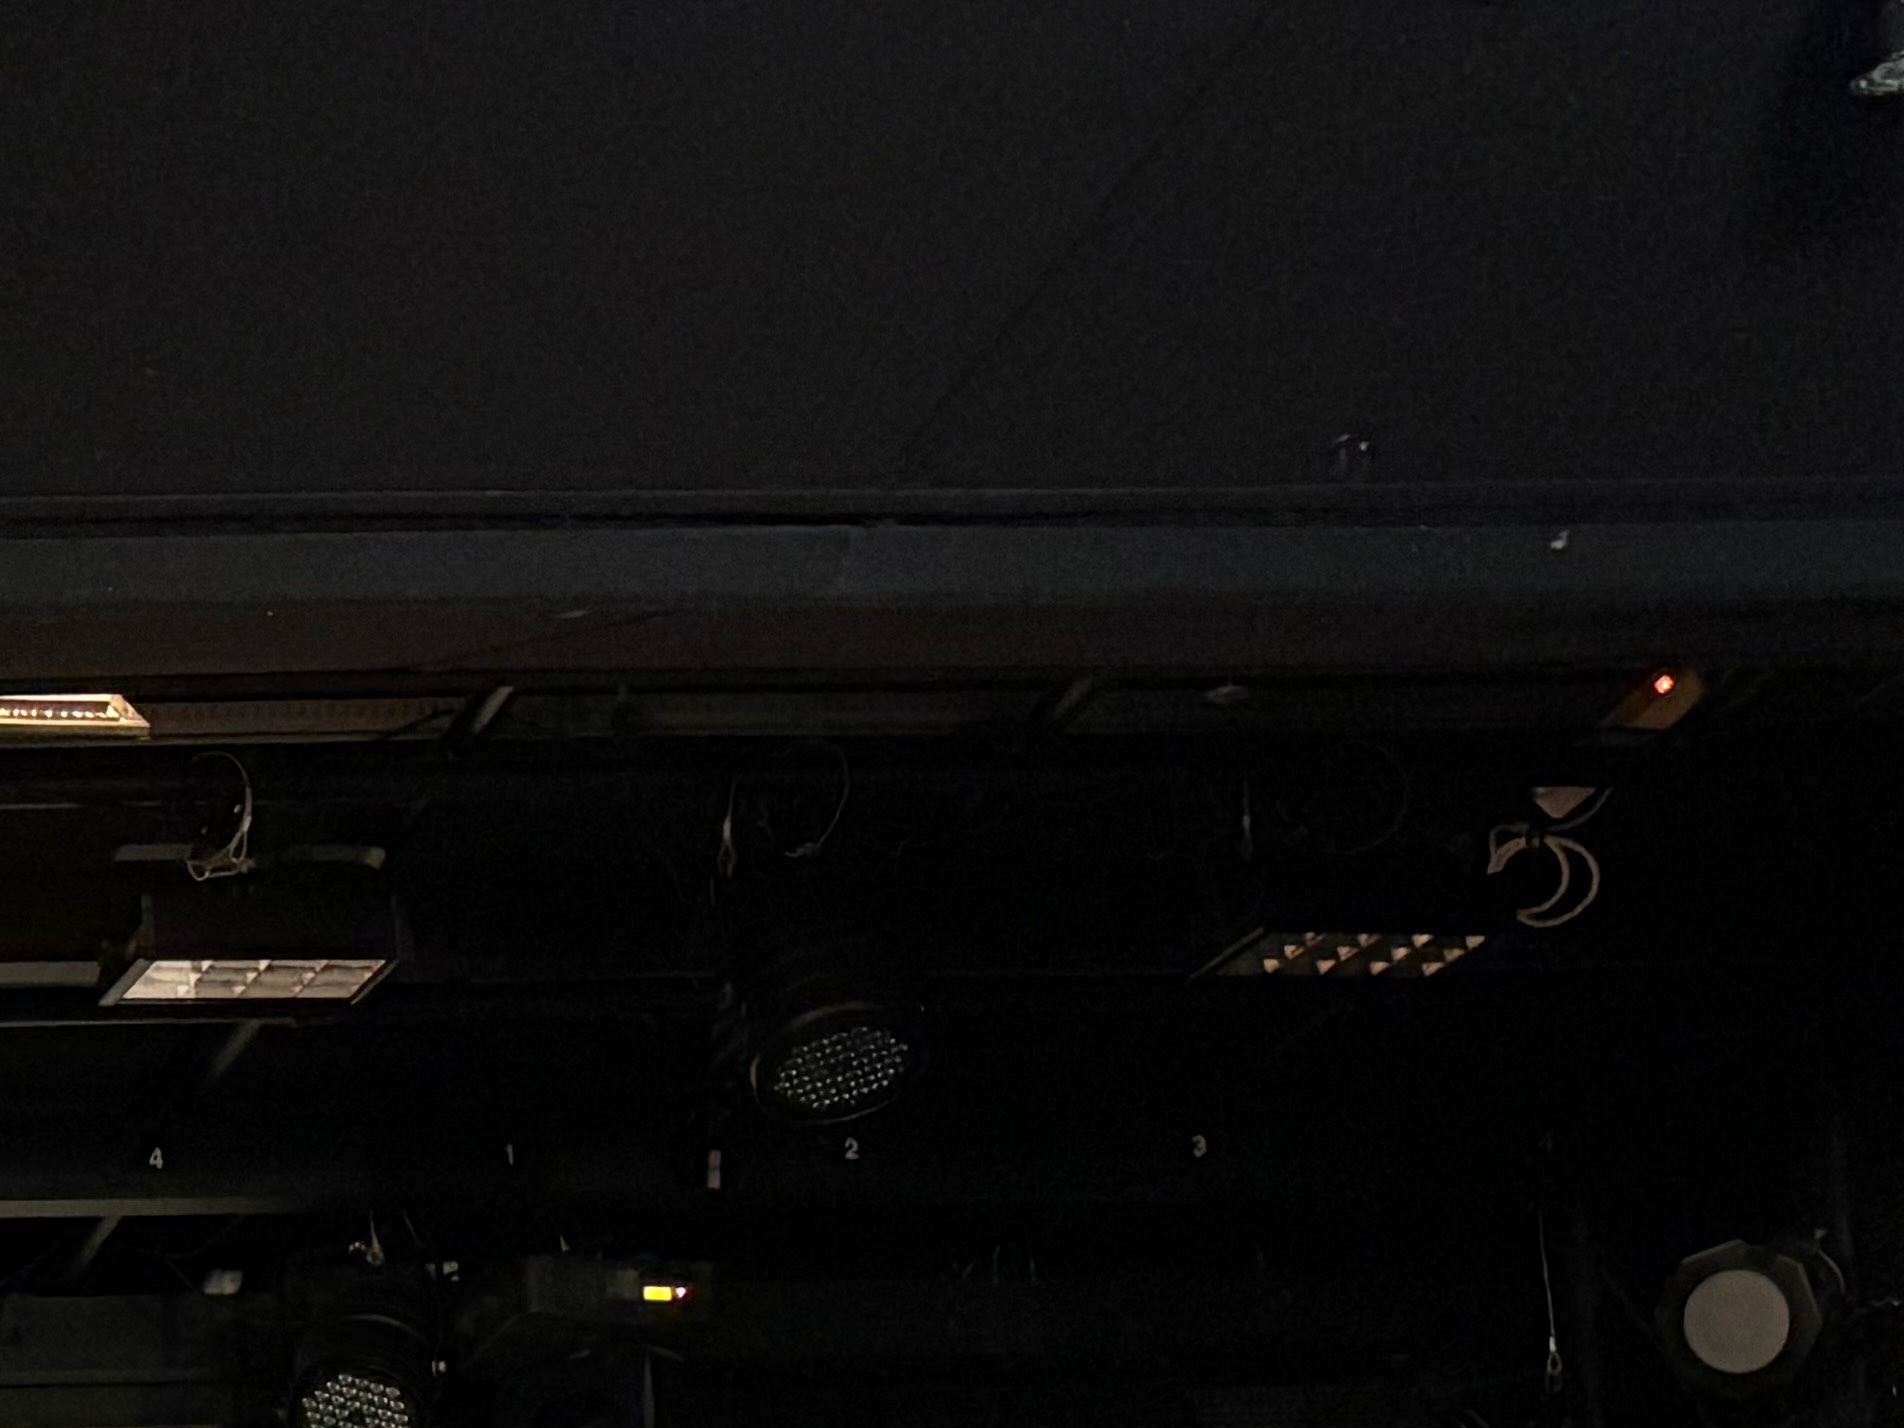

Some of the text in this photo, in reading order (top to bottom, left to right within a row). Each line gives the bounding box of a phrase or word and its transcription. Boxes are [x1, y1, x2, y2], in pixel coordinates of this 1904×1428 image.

[844, 1137, 859, 1160] 2
[1192, 1134, 1207, 1158] 3
[148, 1147, 164, 1169] 4
